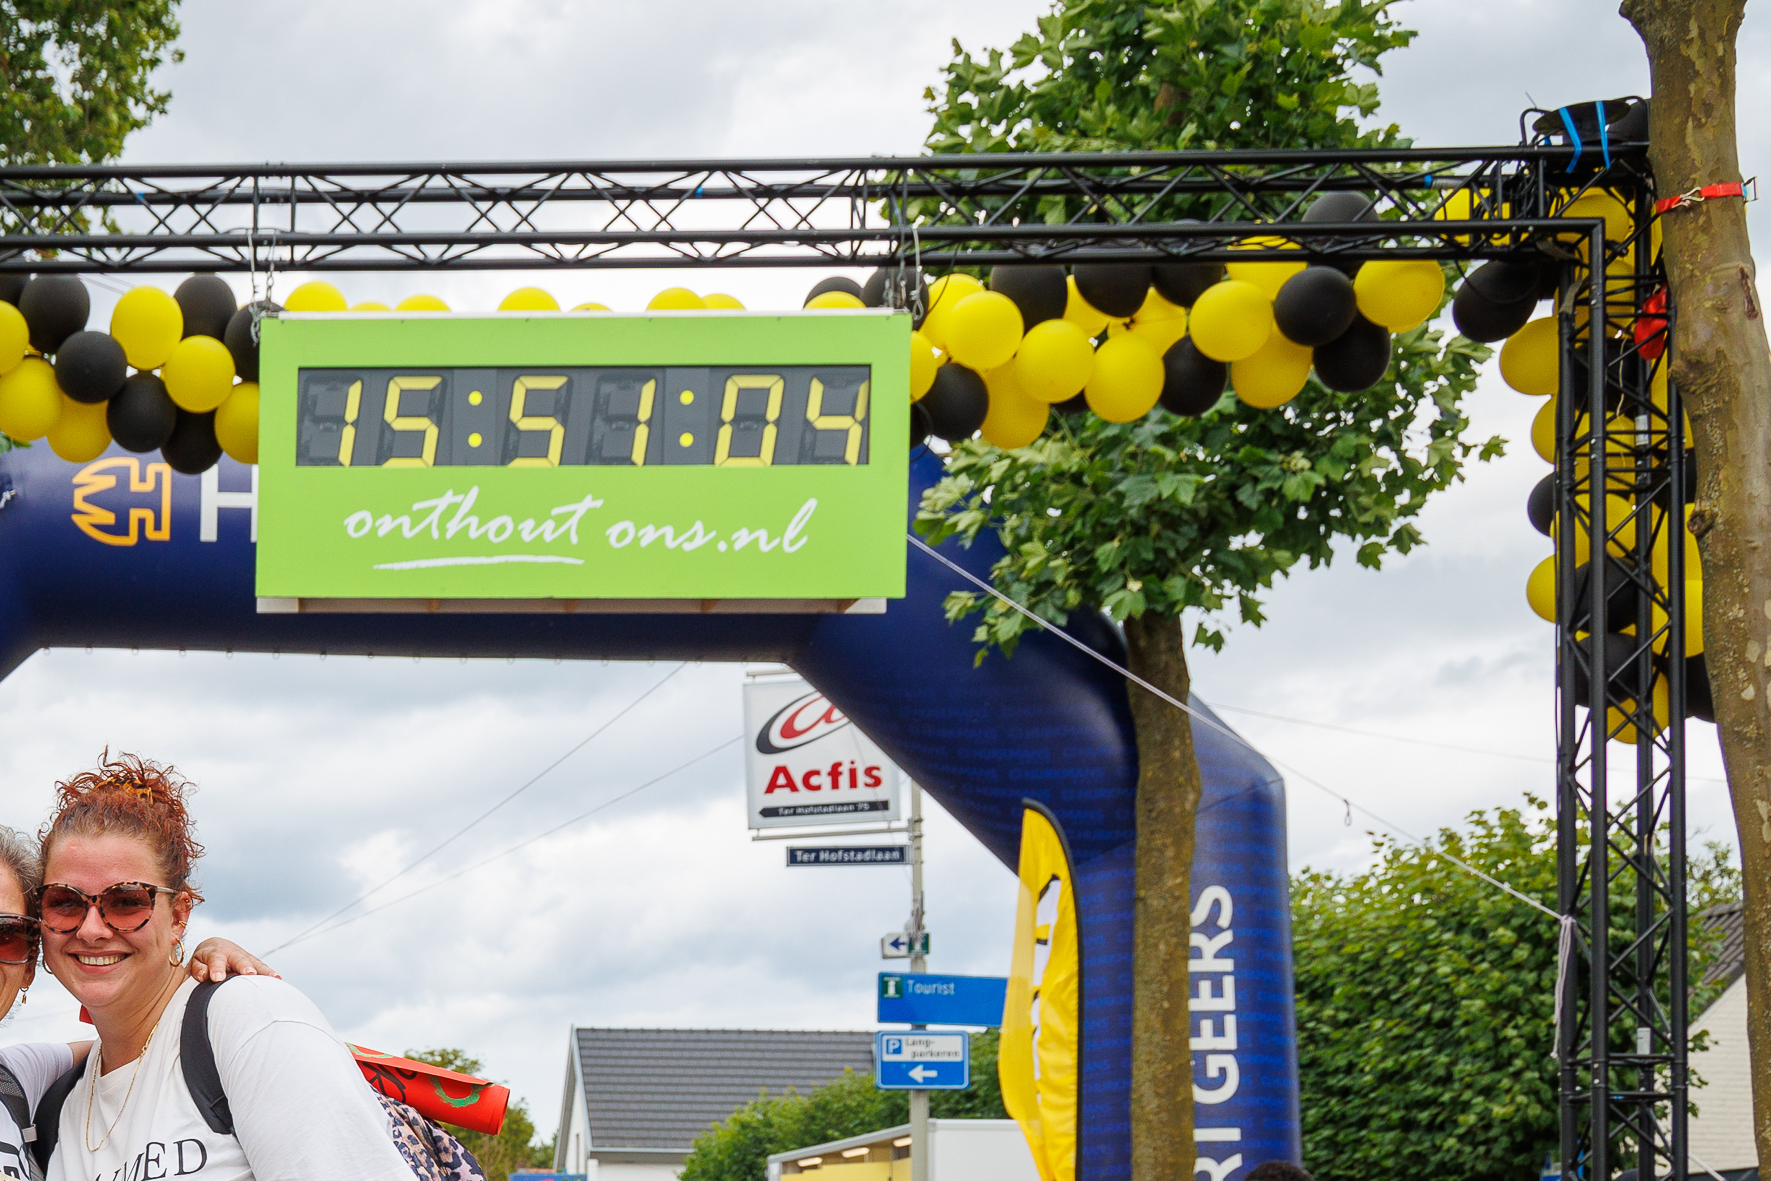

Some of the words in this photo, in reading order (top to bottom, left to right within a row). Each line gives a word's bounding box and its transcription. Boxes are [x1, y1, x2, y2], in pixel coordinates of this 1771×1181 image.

[337, 374, 870, 468] 15:51:04
[343, 484, 605, 546] onthout
[604, 497, 819, 553] ons.nl
[764, 760, 883, 794] Acfis
[794, 850, 816, 863] Ter
[818, 849, 901, 863] Hofstadlaan
[907, 979, 956, 996] Tourist
[1188, 884, 1241, 1105] GEERS
